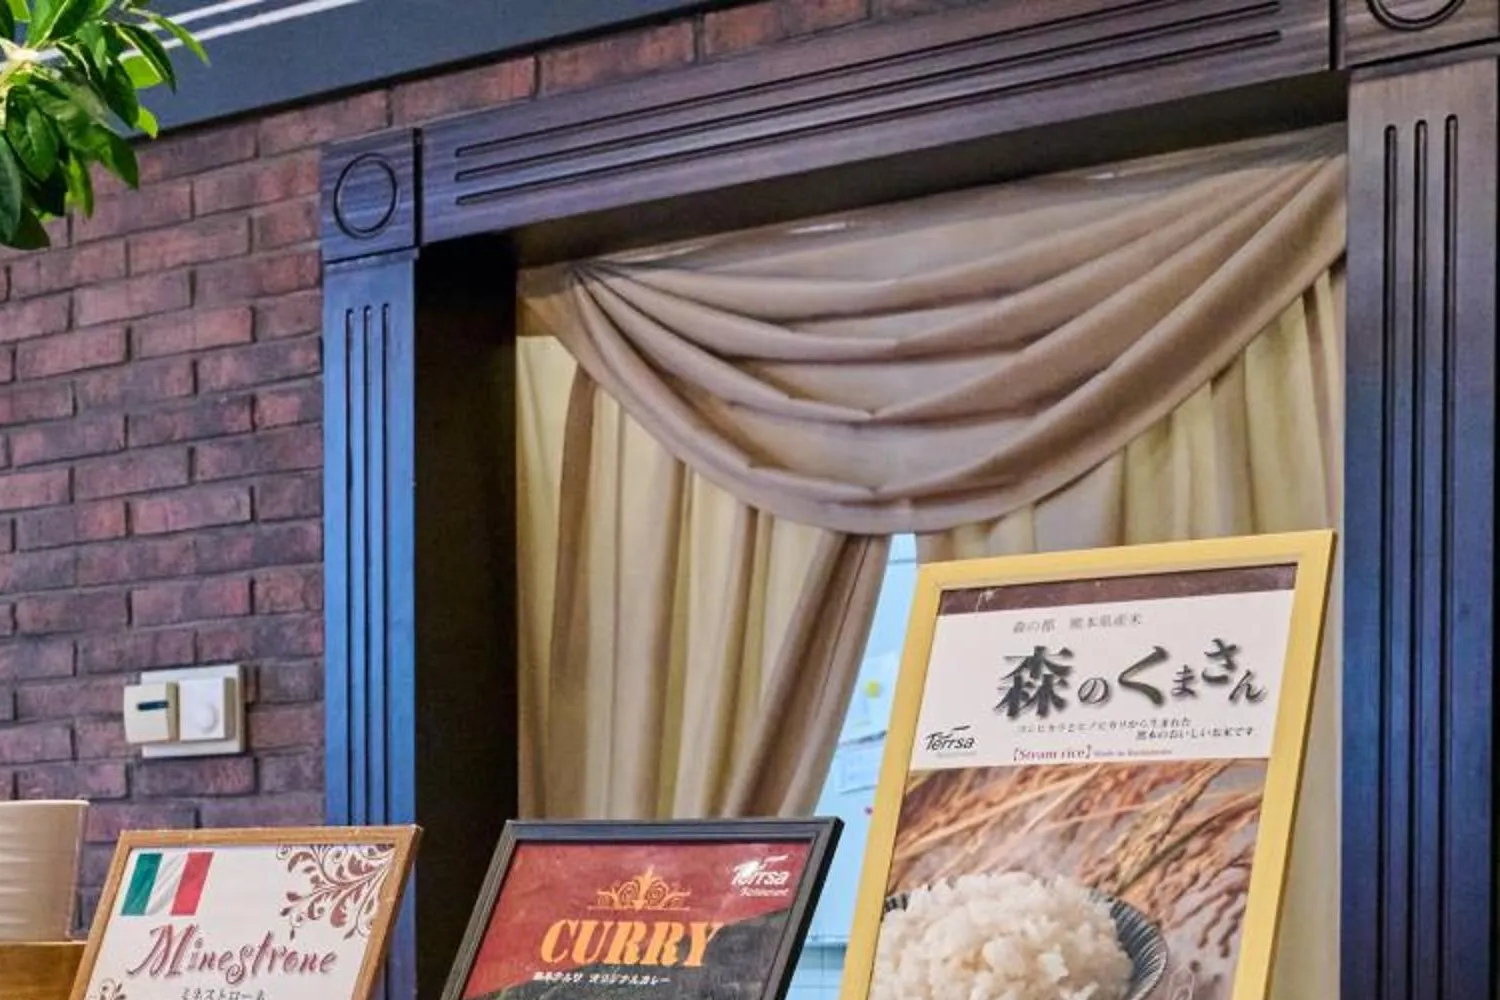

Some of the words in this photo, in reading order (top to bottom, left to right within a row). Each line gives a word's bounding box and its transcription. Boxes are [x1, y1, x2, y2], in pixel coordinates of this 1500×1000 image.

[993, 637, 1267, 718] 森のくまさん
[126, 923, 339, 984] Minestrone
[540, 919, 724, 967] CURRY
